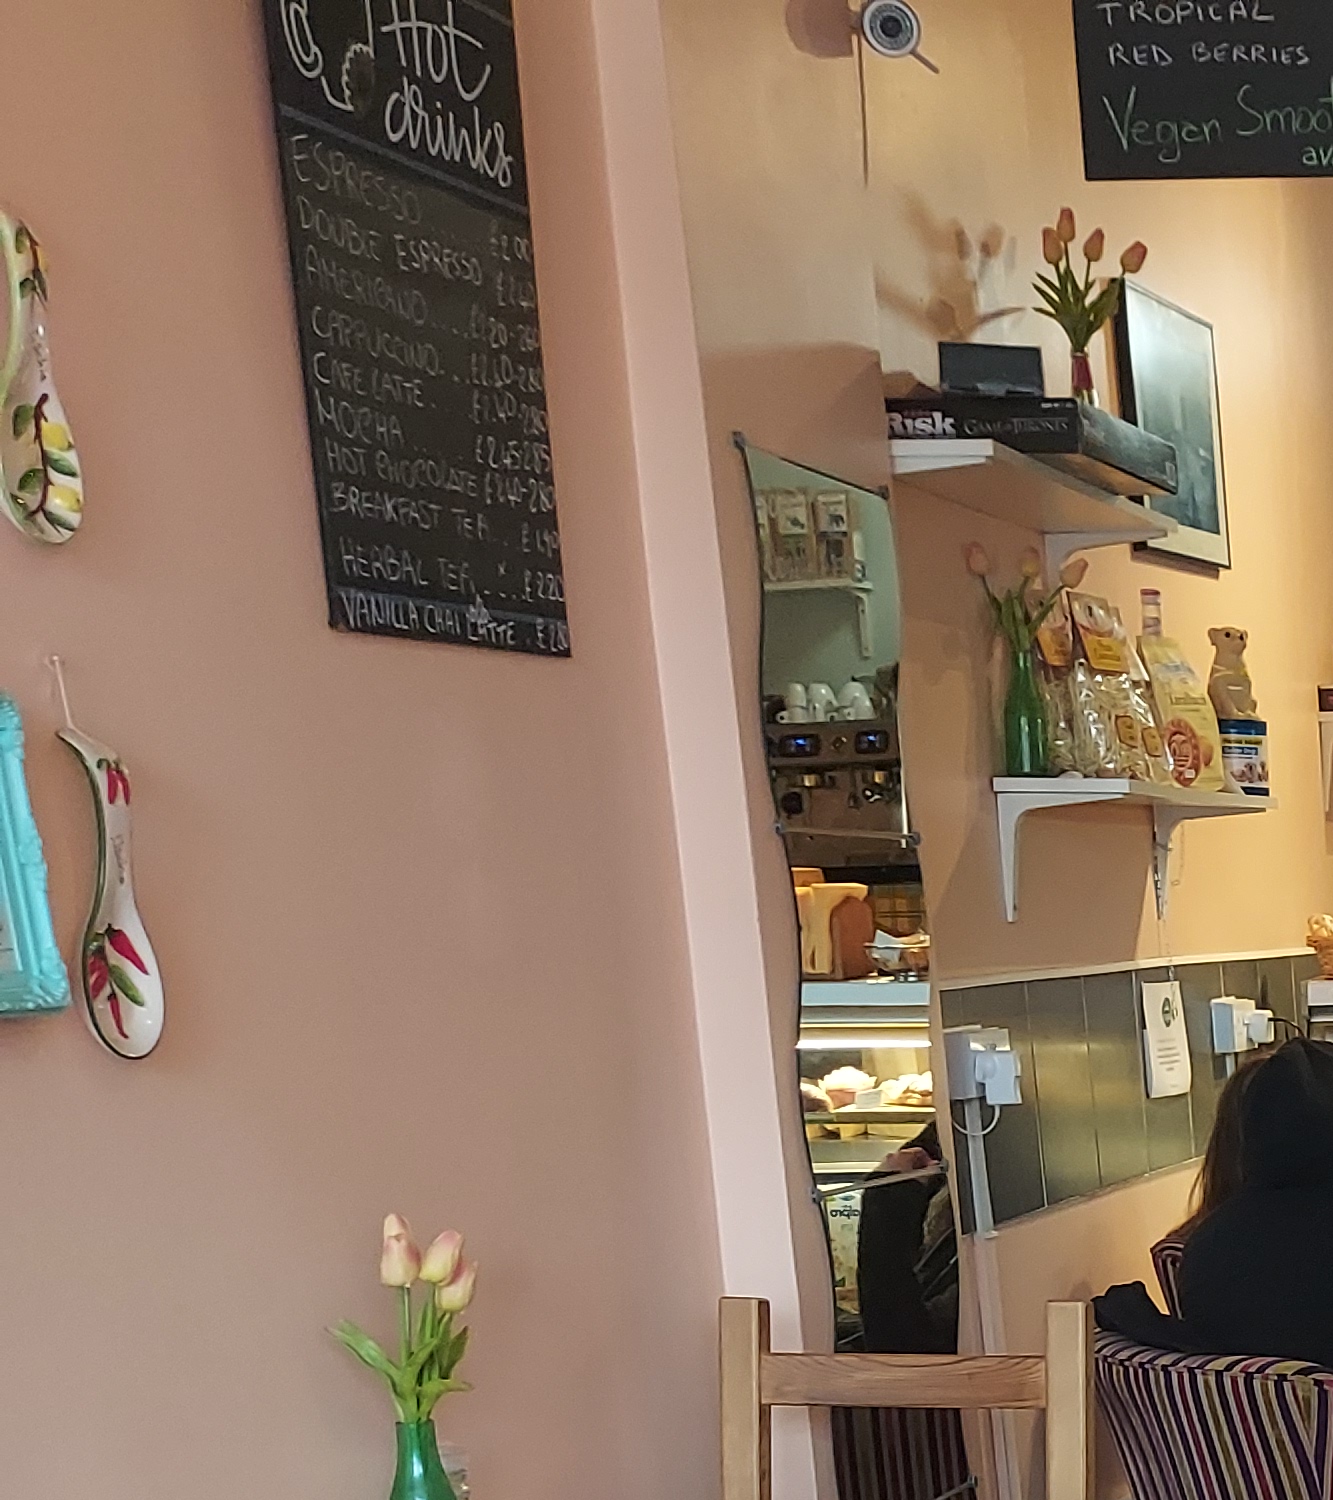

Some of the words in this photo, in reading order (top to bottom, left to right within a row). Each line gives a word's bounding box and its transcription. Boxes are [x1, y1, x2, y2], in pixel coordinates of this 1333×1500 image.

[1097, 0, 1275, 26] TROPICAL
[380, 0, 492, 101] Hot
[1108, 44, 1174, 66] RED
[1192, 42, 1312, 66] BERRIES
[384, 75, 513, 188] drinks
[1101, 86, 1223, 164] Vegan
[393, 233, 483, 286] ESPRESSO
[314, 387, 404, 447] MOCHA
[325, 436, 367, 477] HOT
[331, 481, 442, 530] BREAKFAST
[451, 507, 489, 541] TEA
[340, 590, 419, 630] VANILLA
[424, 604, 460, 636] CHAI
